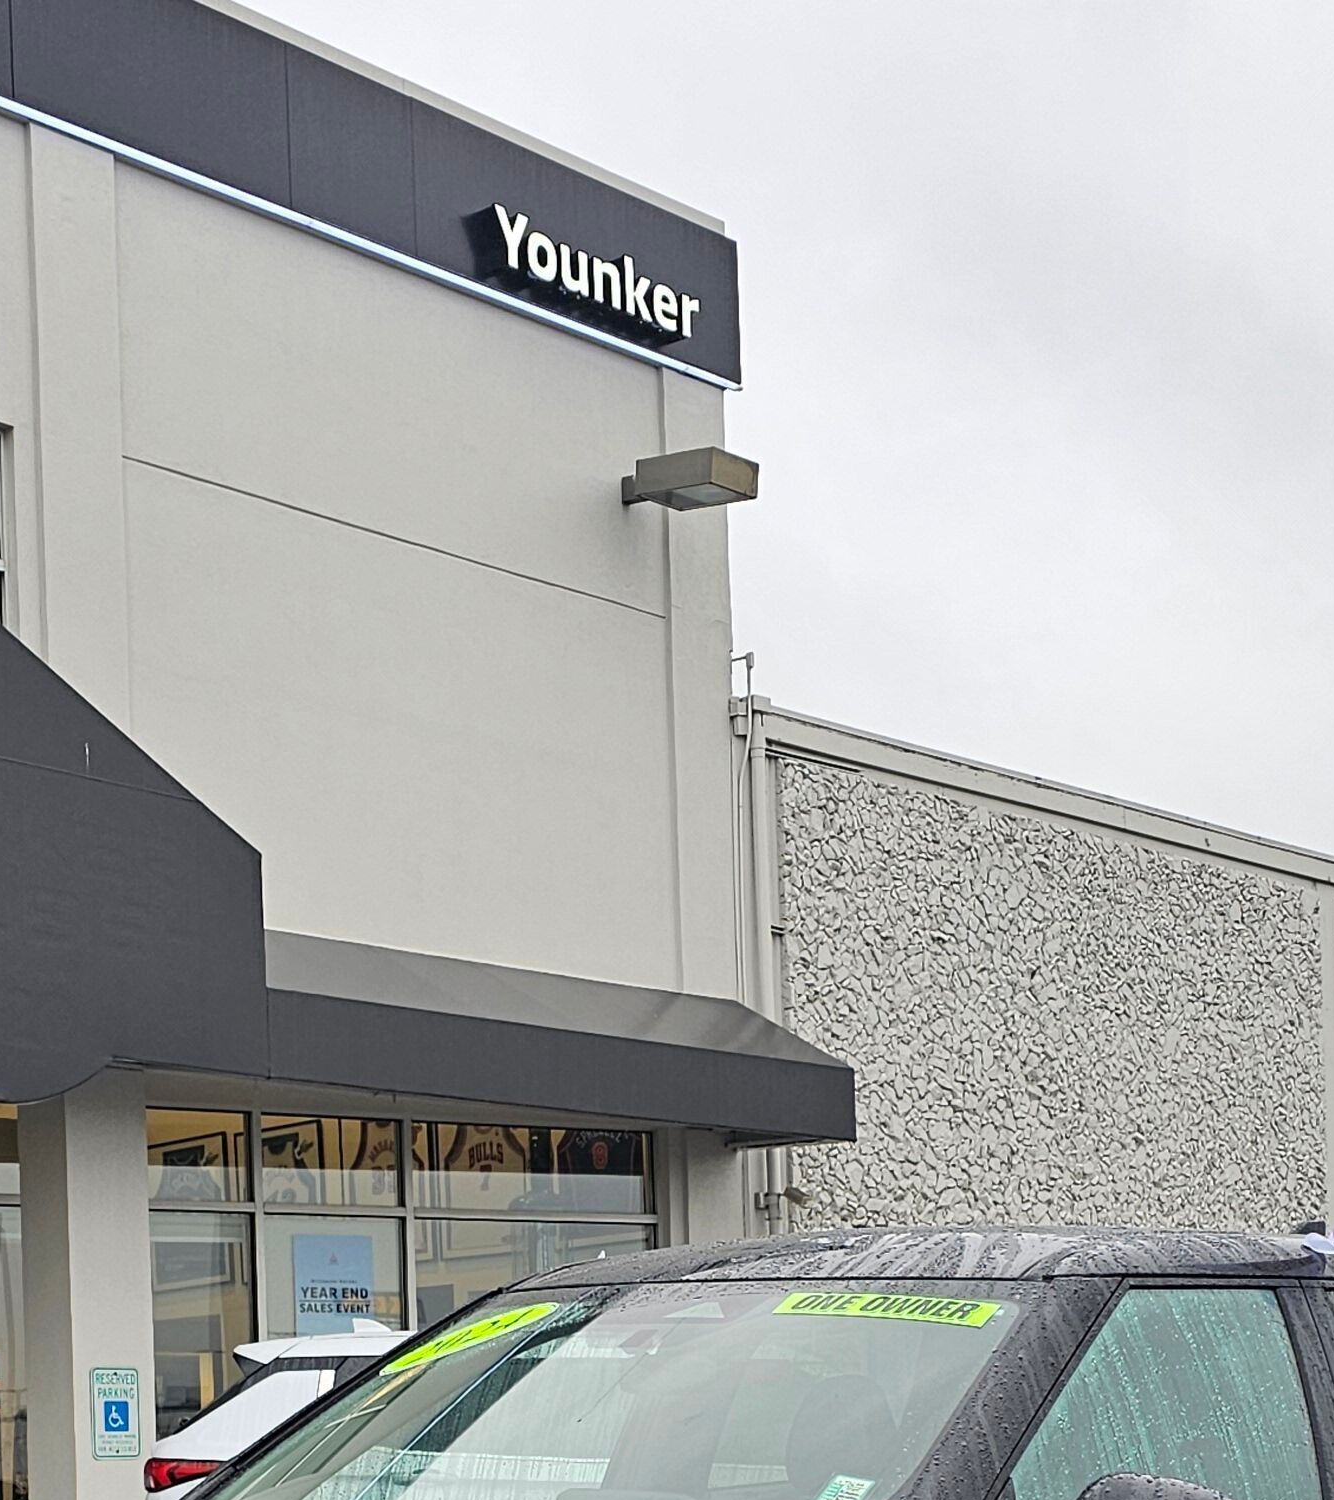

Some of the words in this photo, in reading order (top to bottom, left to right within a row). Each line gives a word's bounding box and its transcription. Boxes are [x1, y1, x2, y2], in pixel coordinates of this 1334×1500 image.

[493, 202, 700, 338] Younker
[468, 1143, 504, 1168] BULLS
[300, 1286, 338, 1299] YEAR
[341, 1287, 369, 1299] END
[299, 1303, 333, 1313] SALES
[336, 1303, 371, 1314] EVENT
[790, 1294, 863, 1311] ONE
[859, 1296, 981, 1320] OWNER
[95, 1373, 136, 1385] RESERVED
[97, 1387, 135, 1399] PARKING
